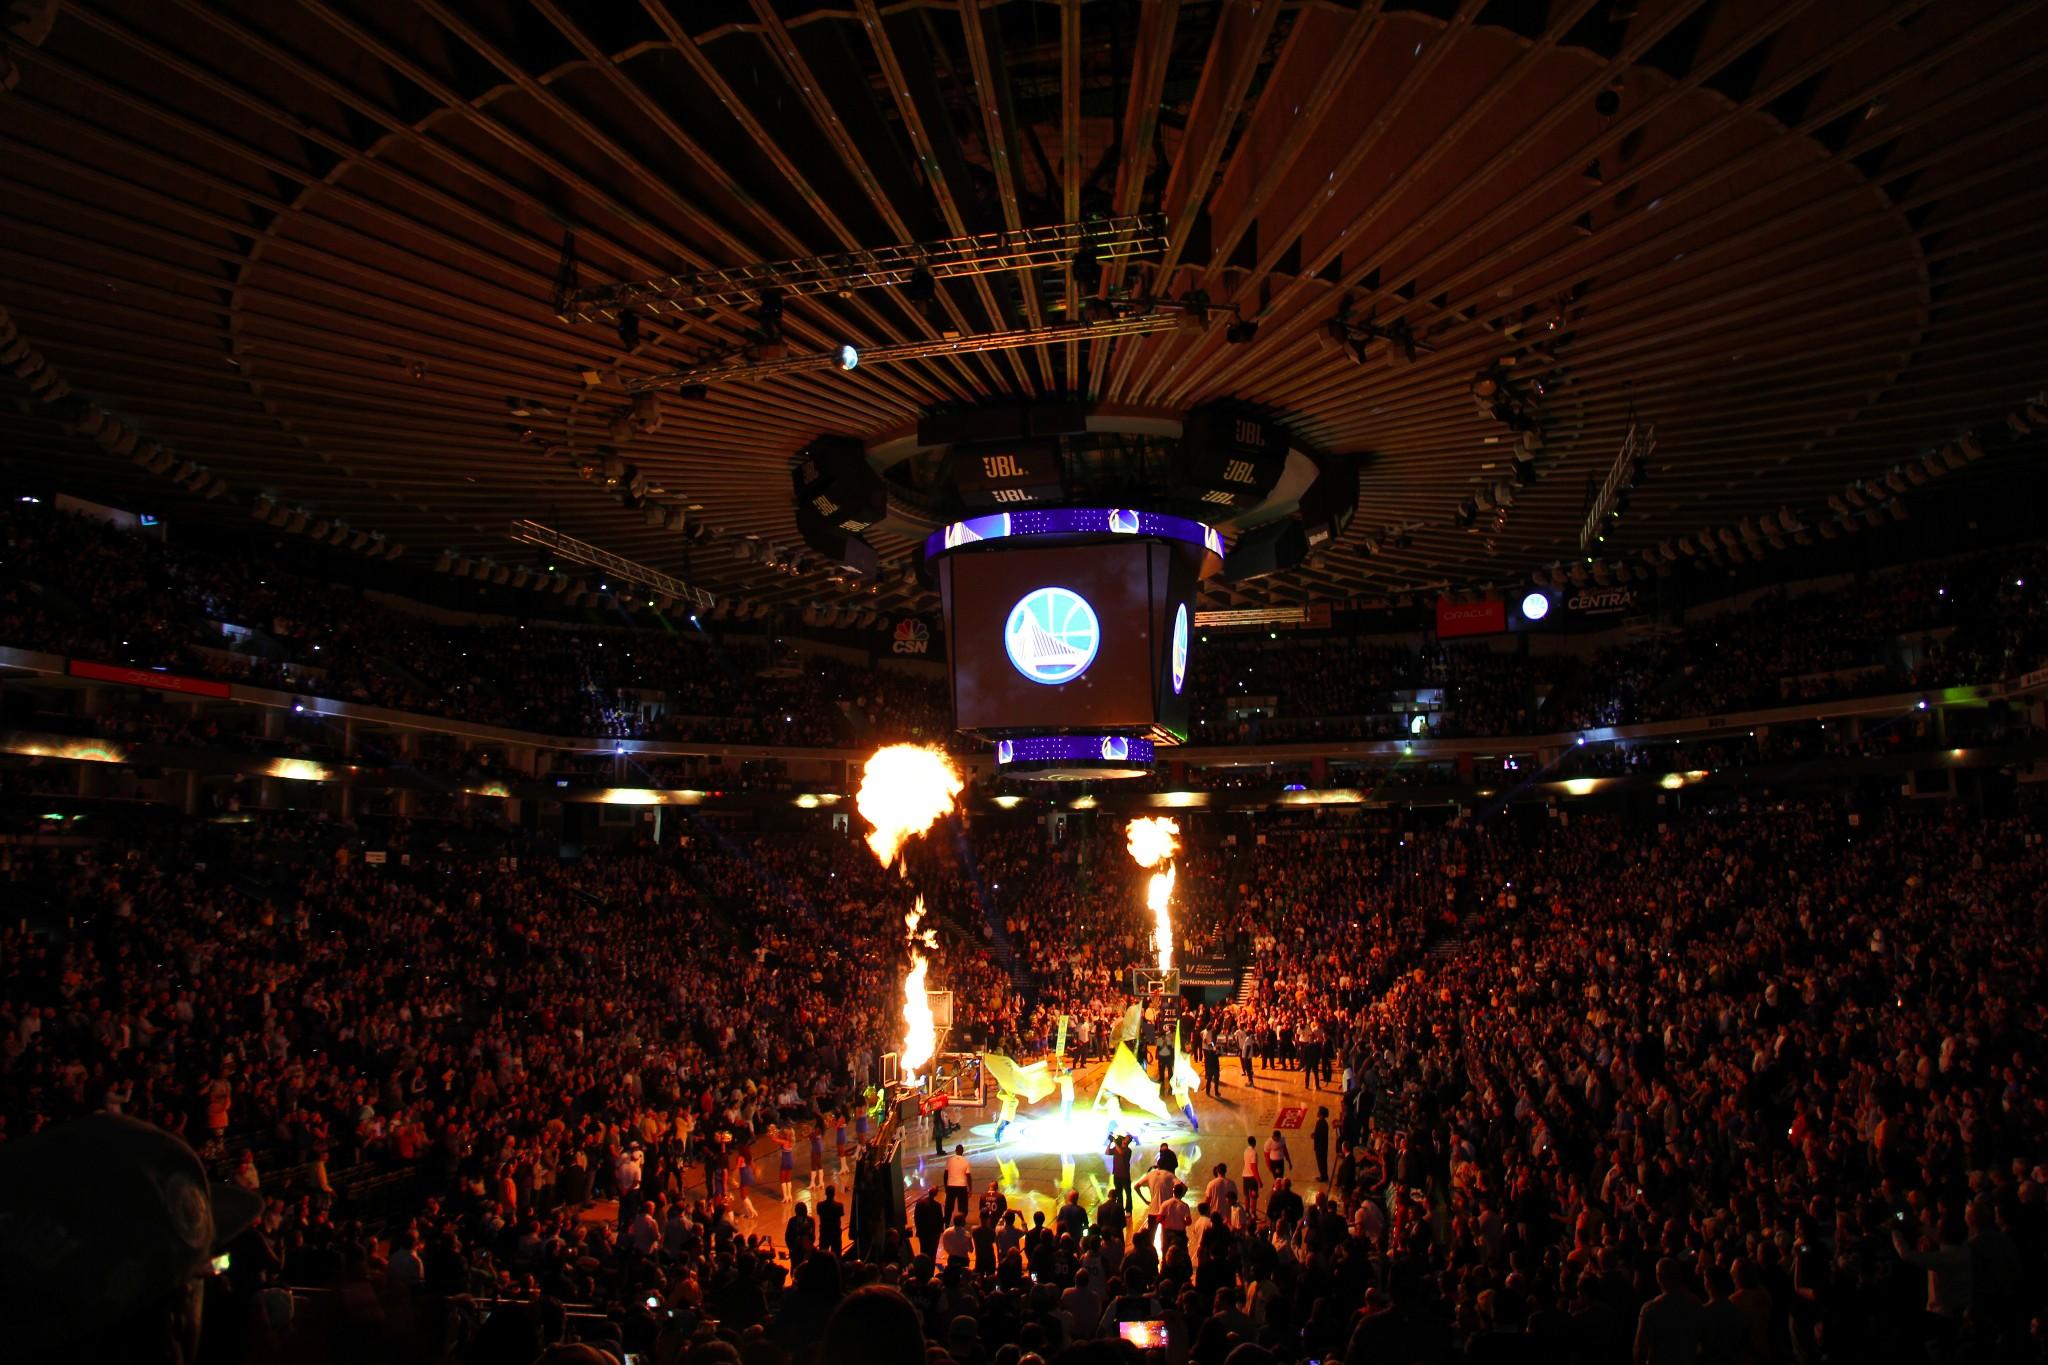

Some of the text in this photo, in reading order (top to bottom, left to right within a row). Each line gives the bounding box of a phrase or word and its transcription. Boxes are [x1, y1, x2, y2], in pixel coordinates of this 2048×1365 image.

[1234, 418, 1265, 447] JBL
[981, 455, 1024, 478] JBL
[1223, 458, 1256, 485] JBL
[991, 489, 1033, 503] JBL
[1201, 490, 1234, 505] JBL
[811, 495, 839, 516] JBL
[1443, 608, 1494, 621] ORACLE
[892, 640, 929, 654] CSN
